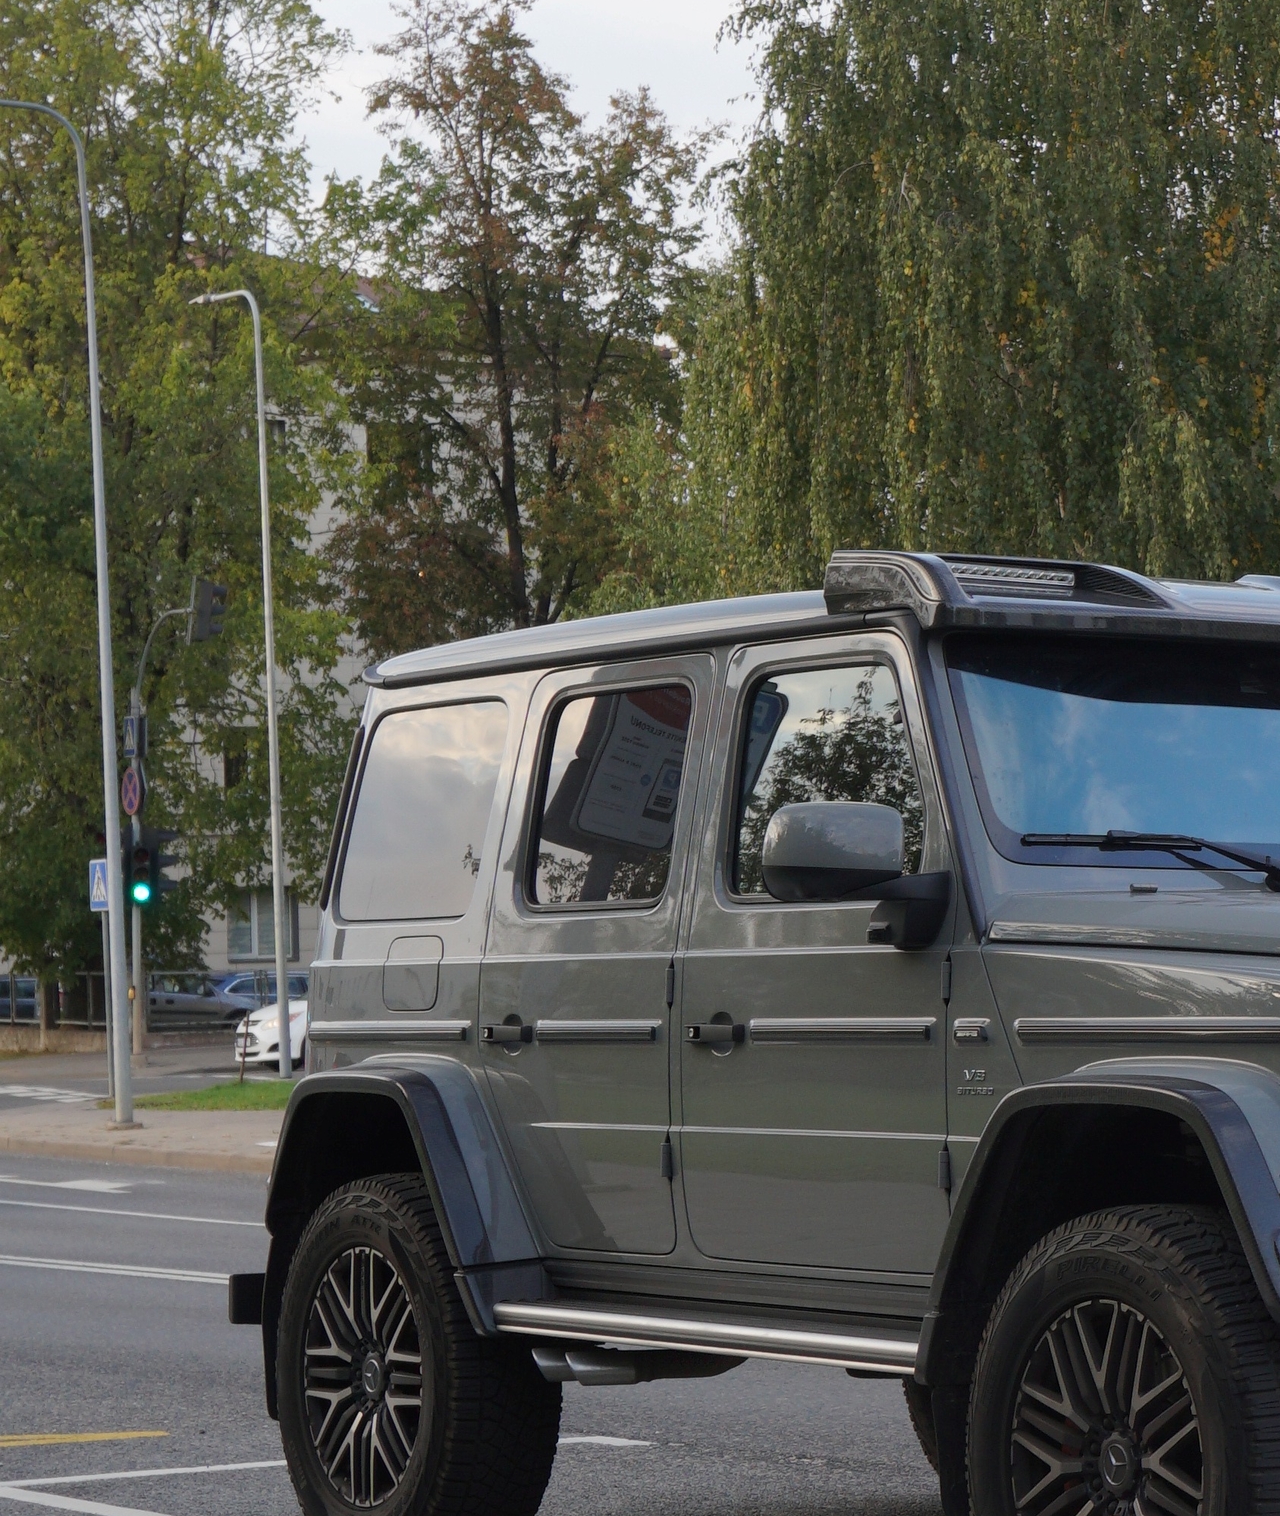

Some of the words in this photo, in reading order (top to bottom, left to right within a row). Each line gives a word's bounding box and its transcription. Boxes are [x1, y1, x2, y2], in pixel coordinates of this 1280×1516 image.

[963, 1069, 986, 1081] V8
[957, 1086, 995, 1095] BITURBO
[1057, 1256, 1162, 1301] PIRELLI
